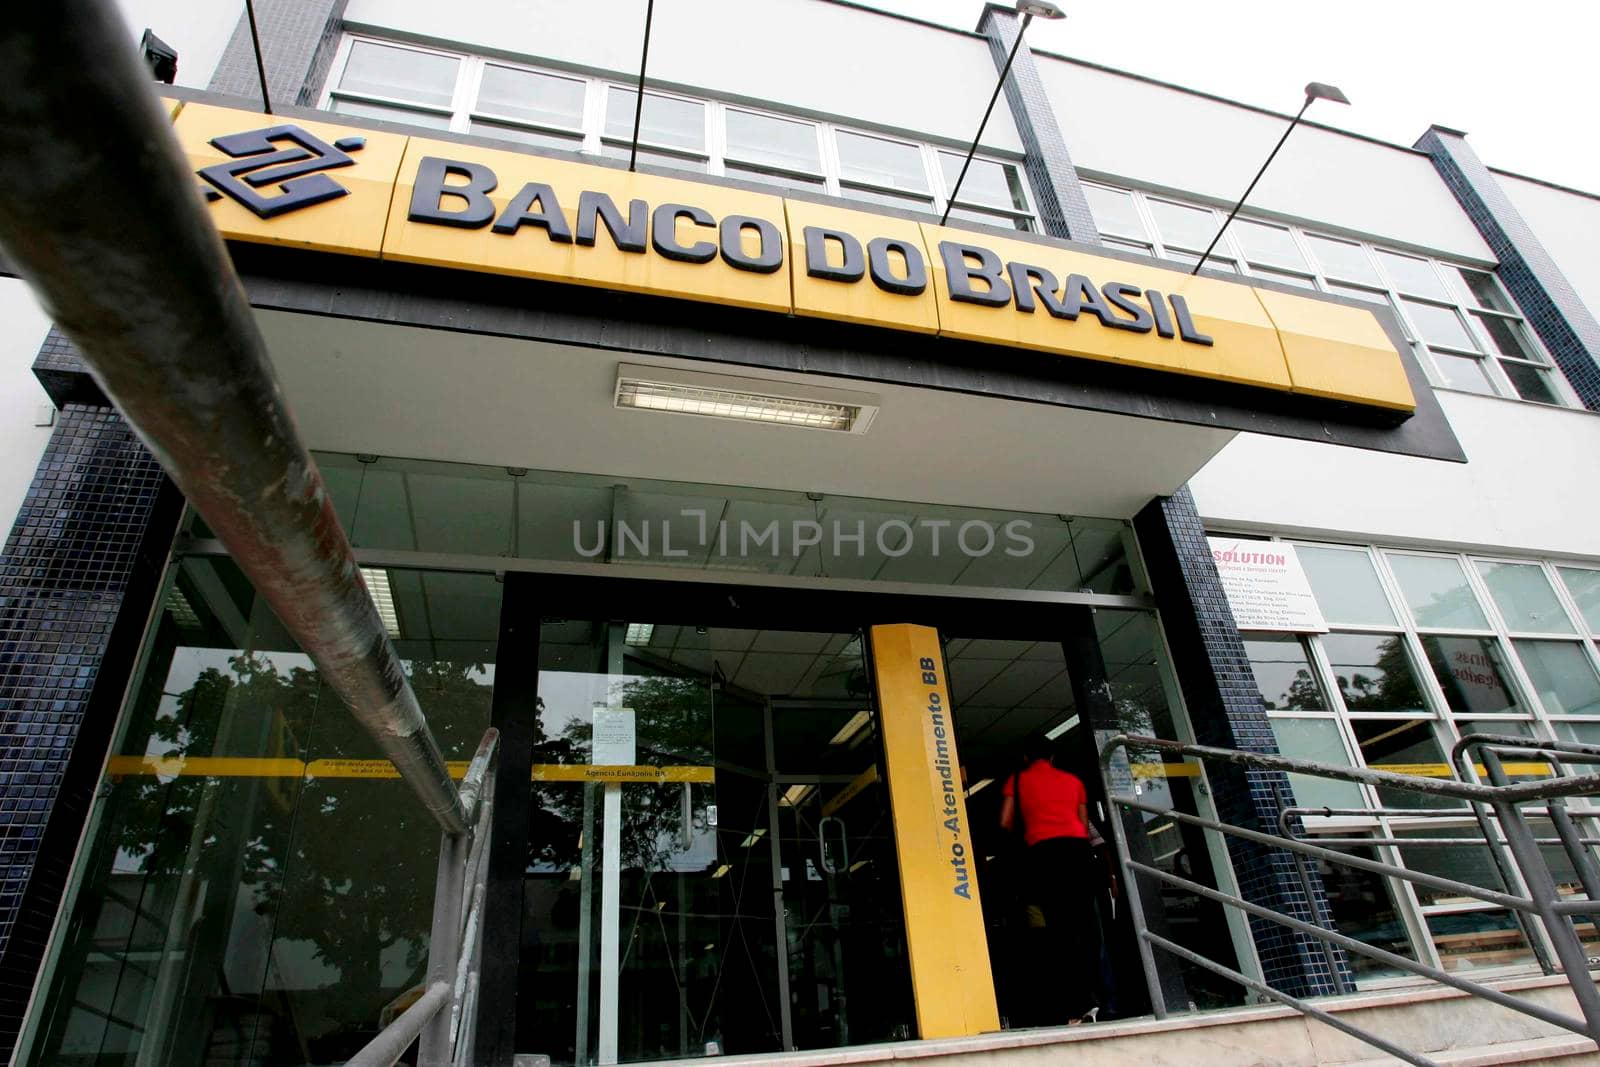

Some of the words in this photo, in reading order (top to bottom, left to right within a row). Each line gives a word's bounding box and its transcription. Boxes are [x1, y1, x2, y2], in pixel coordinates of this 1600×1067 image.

[407, 156, 783, 274] BANCO
[803, 225, 927, 296] DO
[940, 240, 1214, 347] BRASIL
[1213, 549, 1286, 566] SOLUTION
[919, 657, 938, 686] BB
